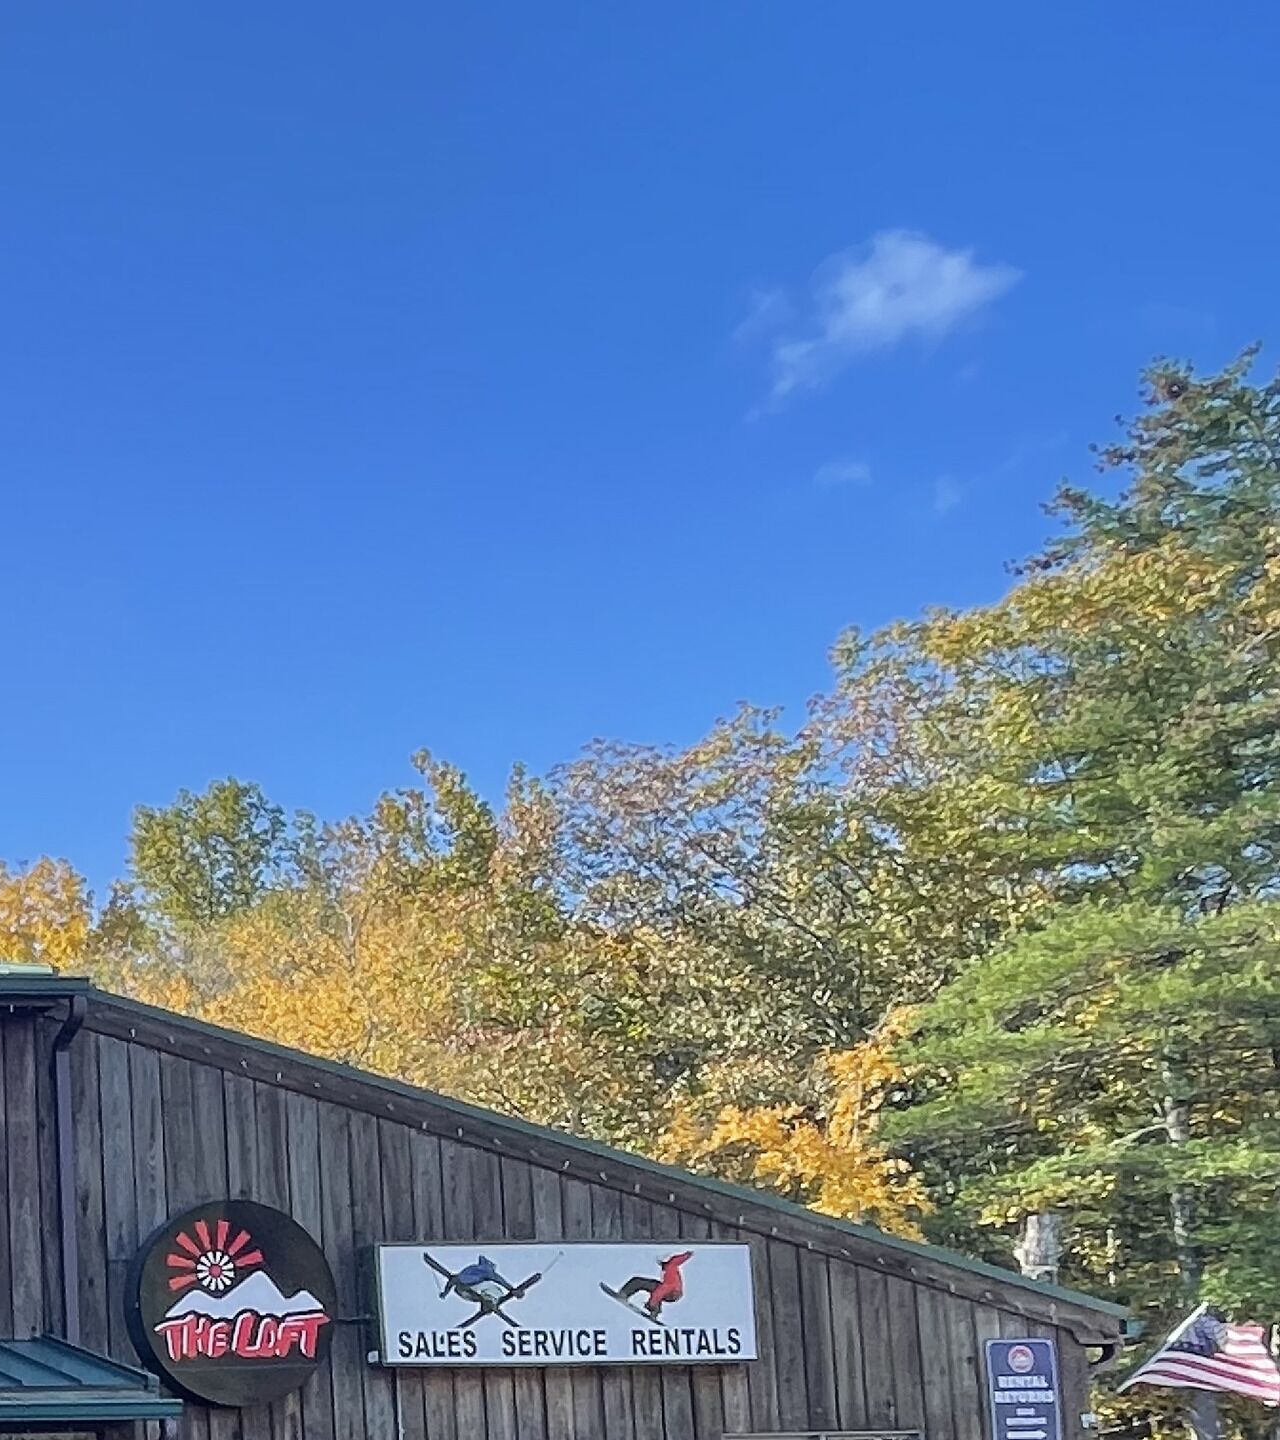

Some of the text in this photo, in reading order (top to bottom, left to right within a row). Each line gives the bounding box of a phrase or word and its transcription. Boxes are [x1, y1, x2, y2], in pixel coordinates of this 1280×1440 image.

[154, 1312, 331, 1362] THE LOFT
[398, 1328, 742, 1358] SALES SERVICE RENTALS
